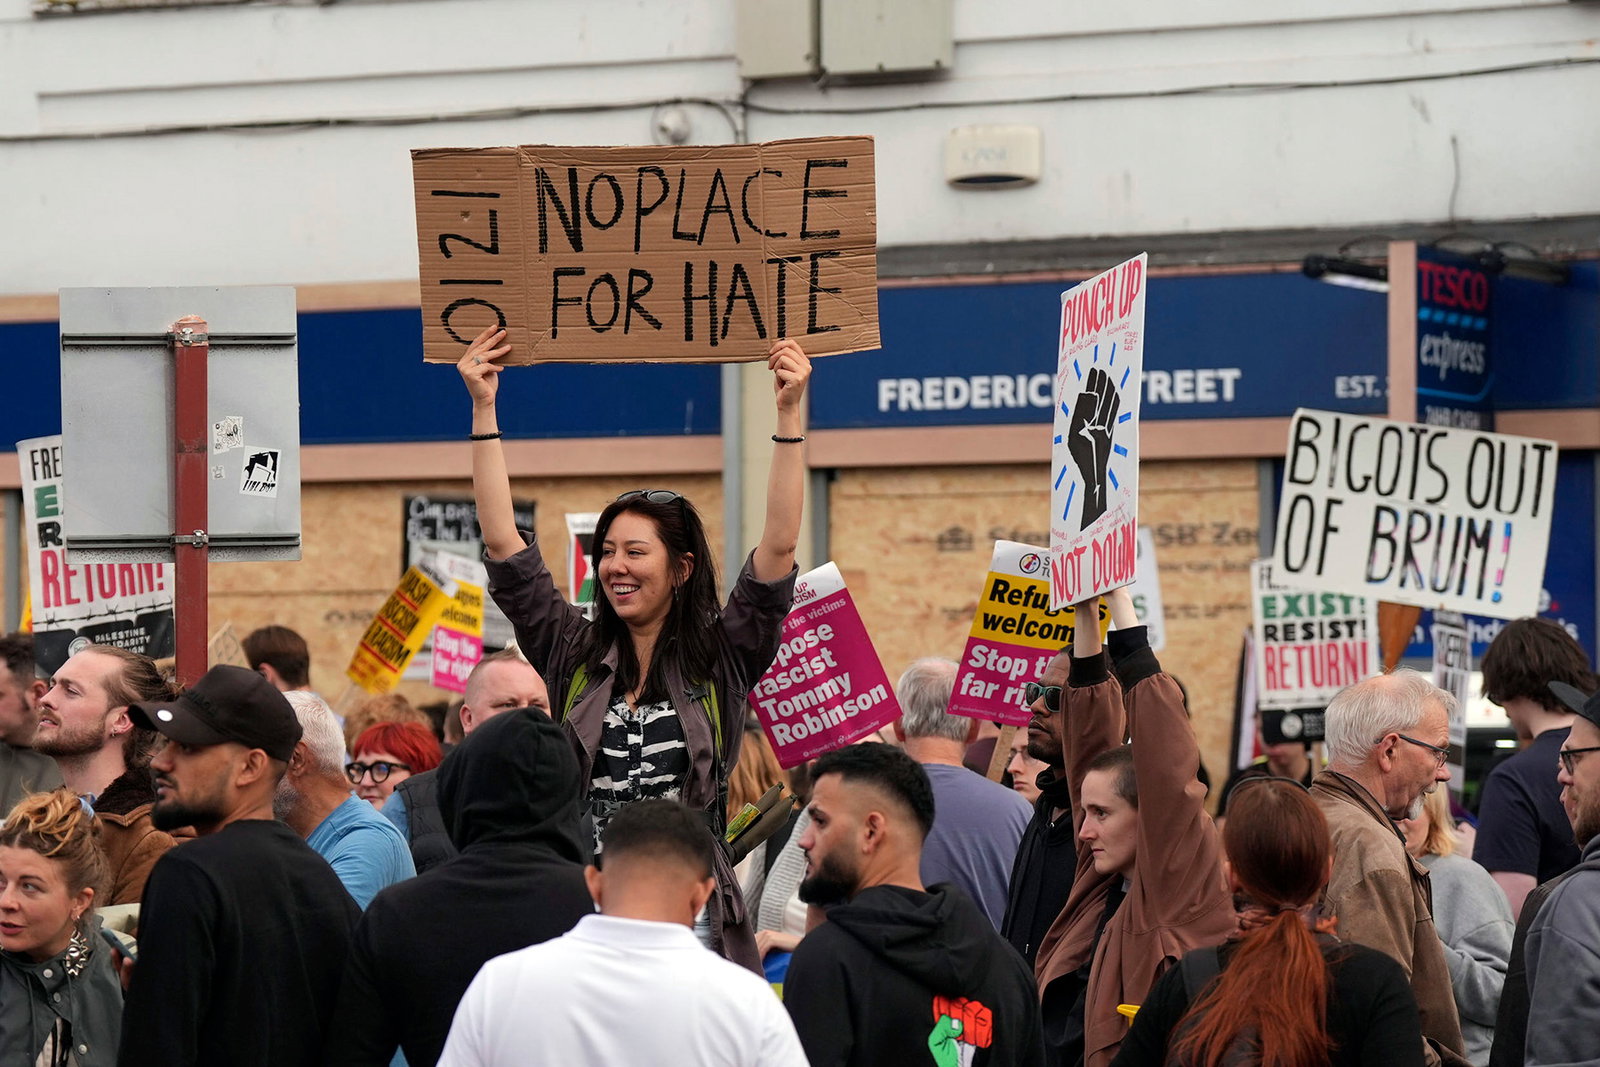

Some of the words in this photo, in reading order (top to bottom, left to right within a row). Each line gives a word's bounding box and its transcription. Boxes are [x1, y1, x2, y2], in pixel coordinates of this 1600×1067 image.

[534, 166, 625, 254] NO
[634, 158, 849, 254] PLACE
[551, 266, 663, 340] FOR
[682, 250, 843, 347] HATE
[1061, 267, 1117, 352] PUNCH
[1119, 259, 1142, 319] UP
[1418, 260, 1488, 312] TESCO
[1420, 331, 1486, 382] express
[878, 373, 1058, 412] FREDERIC
[1142, 367, 1242, 405] REET
[1335, 375, 1381, 399] EST.
[30, 445, 63, 481] FRE
[1288, 414, 1449, 504] BIGOTS
[1467, 436, 1553, 518] OUT
[1051, 545, 1088, 608] NOT
[1091, 516, 1136, 594] DOWN
[1284, 493, 1344, 576] OF
[1365, 504, 1513, 604] BRUM!
[792, 588, 818, 606] CISM
[794, 581, 808, 594] UP
[989, 578, 1108, 621] Refus
[1262, 592, 1366, 620] EXIST!
[95, 627, 147, 643] PALESTINE
[787, 614, 807, 631] the
[806, 597, 847, 621] victims
[983, 612, 1076, 643] welcom
[1264, 619, 1367, 642] RESIST!
[101, 635, 151, 651] IDARITY
[766, 622, 836, 674] pose
[968, 644, 1029, 681] Stop
[960, 672, 1000, 699] far
[1264, 641, 1369, 691] RETURN!
[758, 671, 852, 722] Tommy
[770, 683, 889, 748] Robinson
